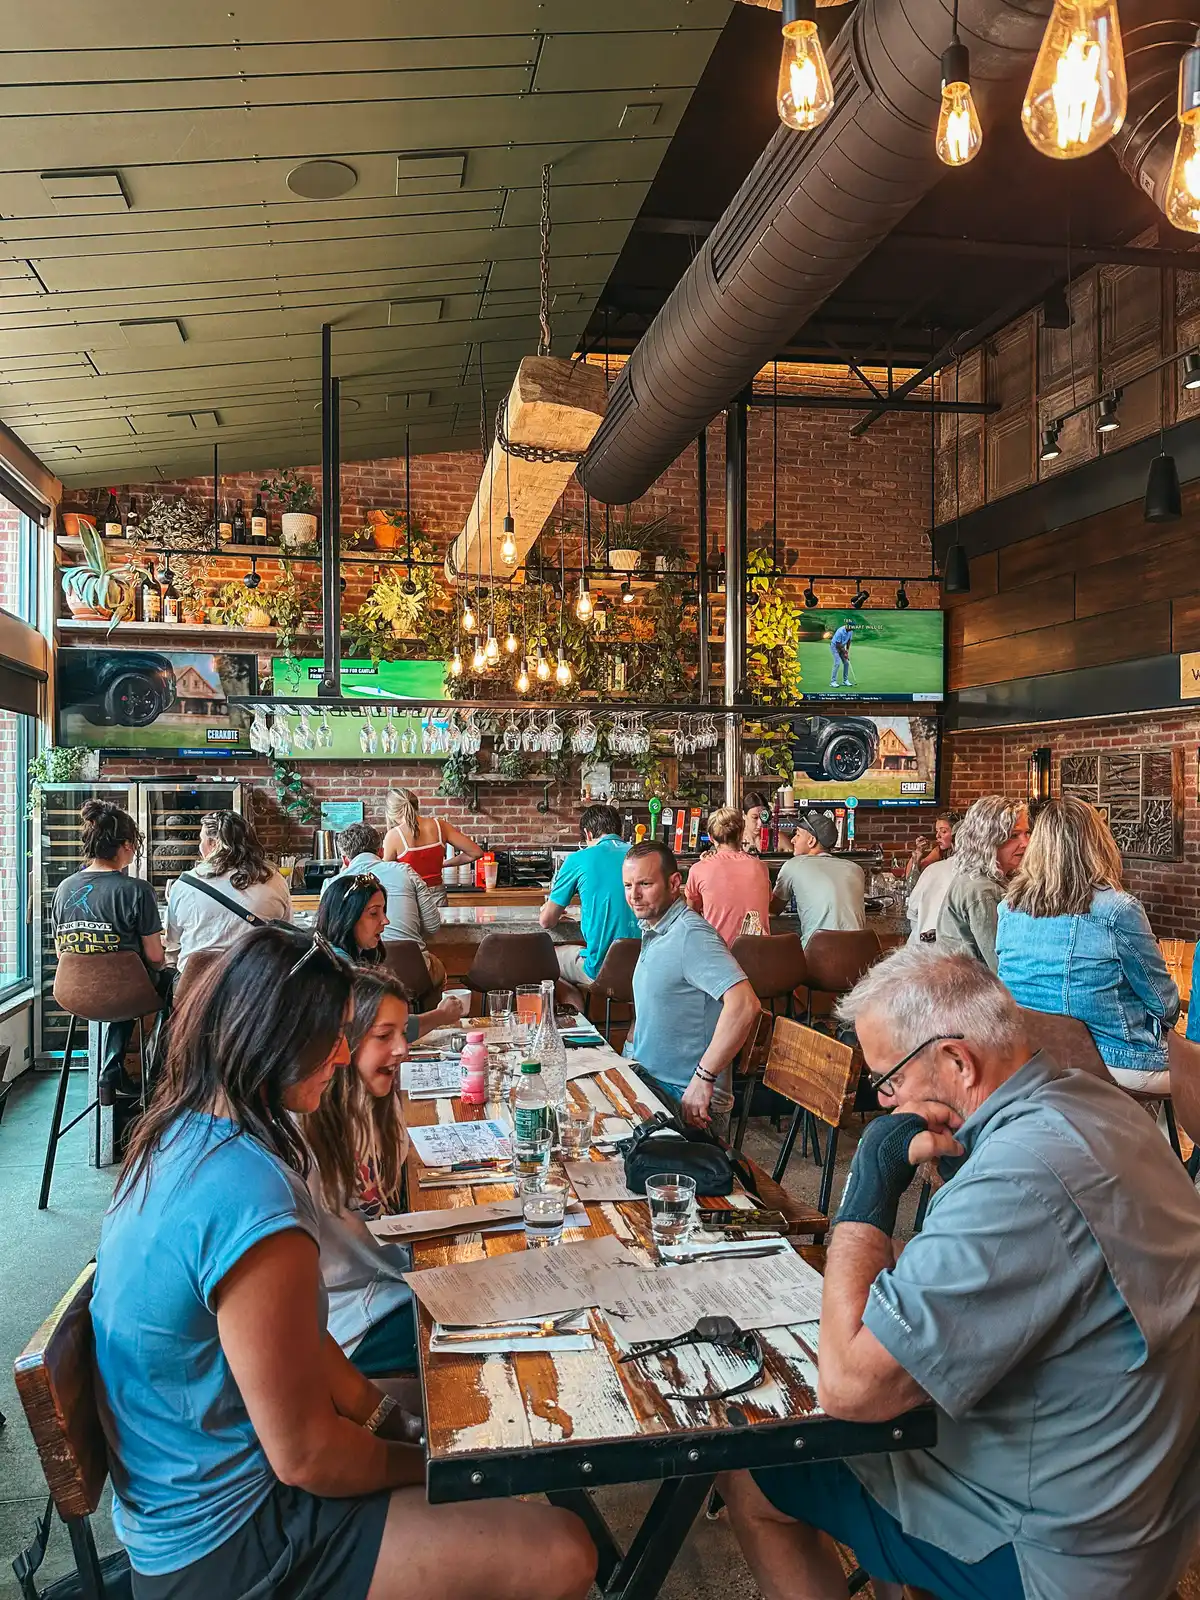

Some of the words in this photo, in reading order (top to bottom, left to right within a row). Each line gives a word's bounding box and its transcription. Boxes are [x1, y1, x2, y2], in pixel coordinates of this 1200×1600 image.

[207, 729, 238, 740] CERAKOTE
[78, 921, 112, 929] FLOYD
[57, 932, 120, 945] WORLD
